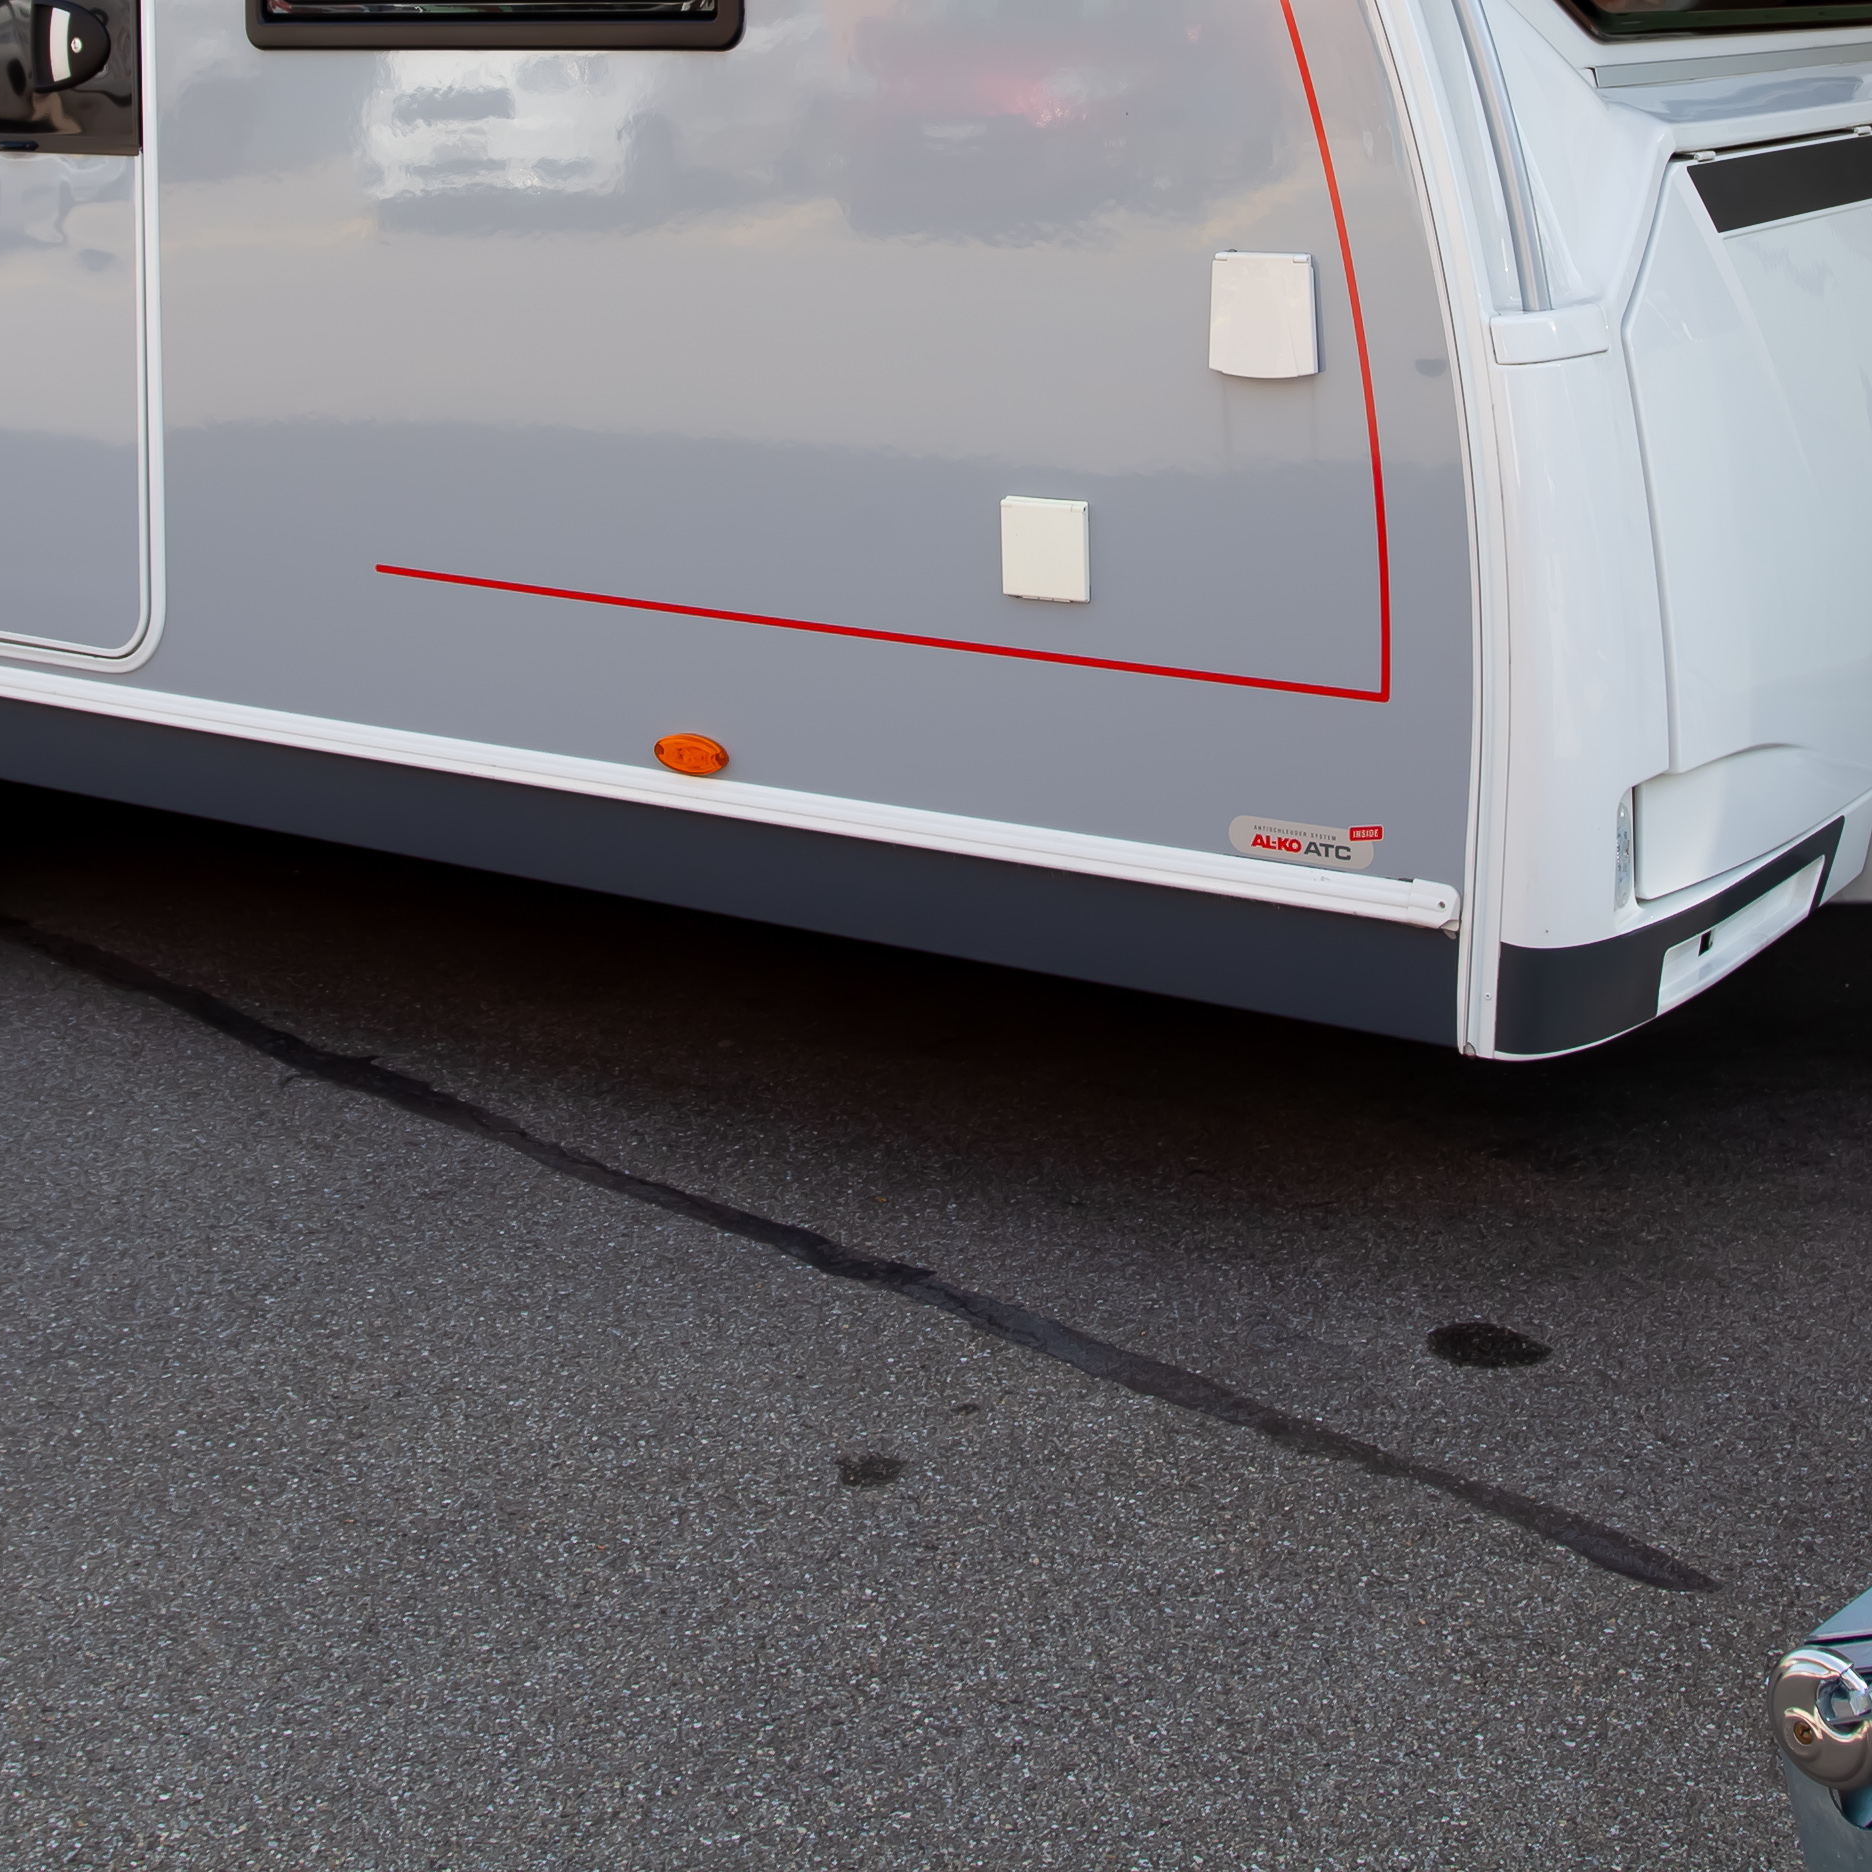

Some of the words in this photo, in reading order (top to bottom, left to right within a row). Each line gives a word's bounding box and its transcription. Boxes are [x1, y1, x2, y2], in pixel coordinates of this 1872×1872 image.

[1253, 824, 1307, 837] ANTISCHLEUDER
[1310, 832, 1337, 841] SYSTEM
[1352, 828, 1379, 839] INSIDE
[1251, 833, 1303, 854] AL-KO
[1303, 841, 1352, 861] ATC
